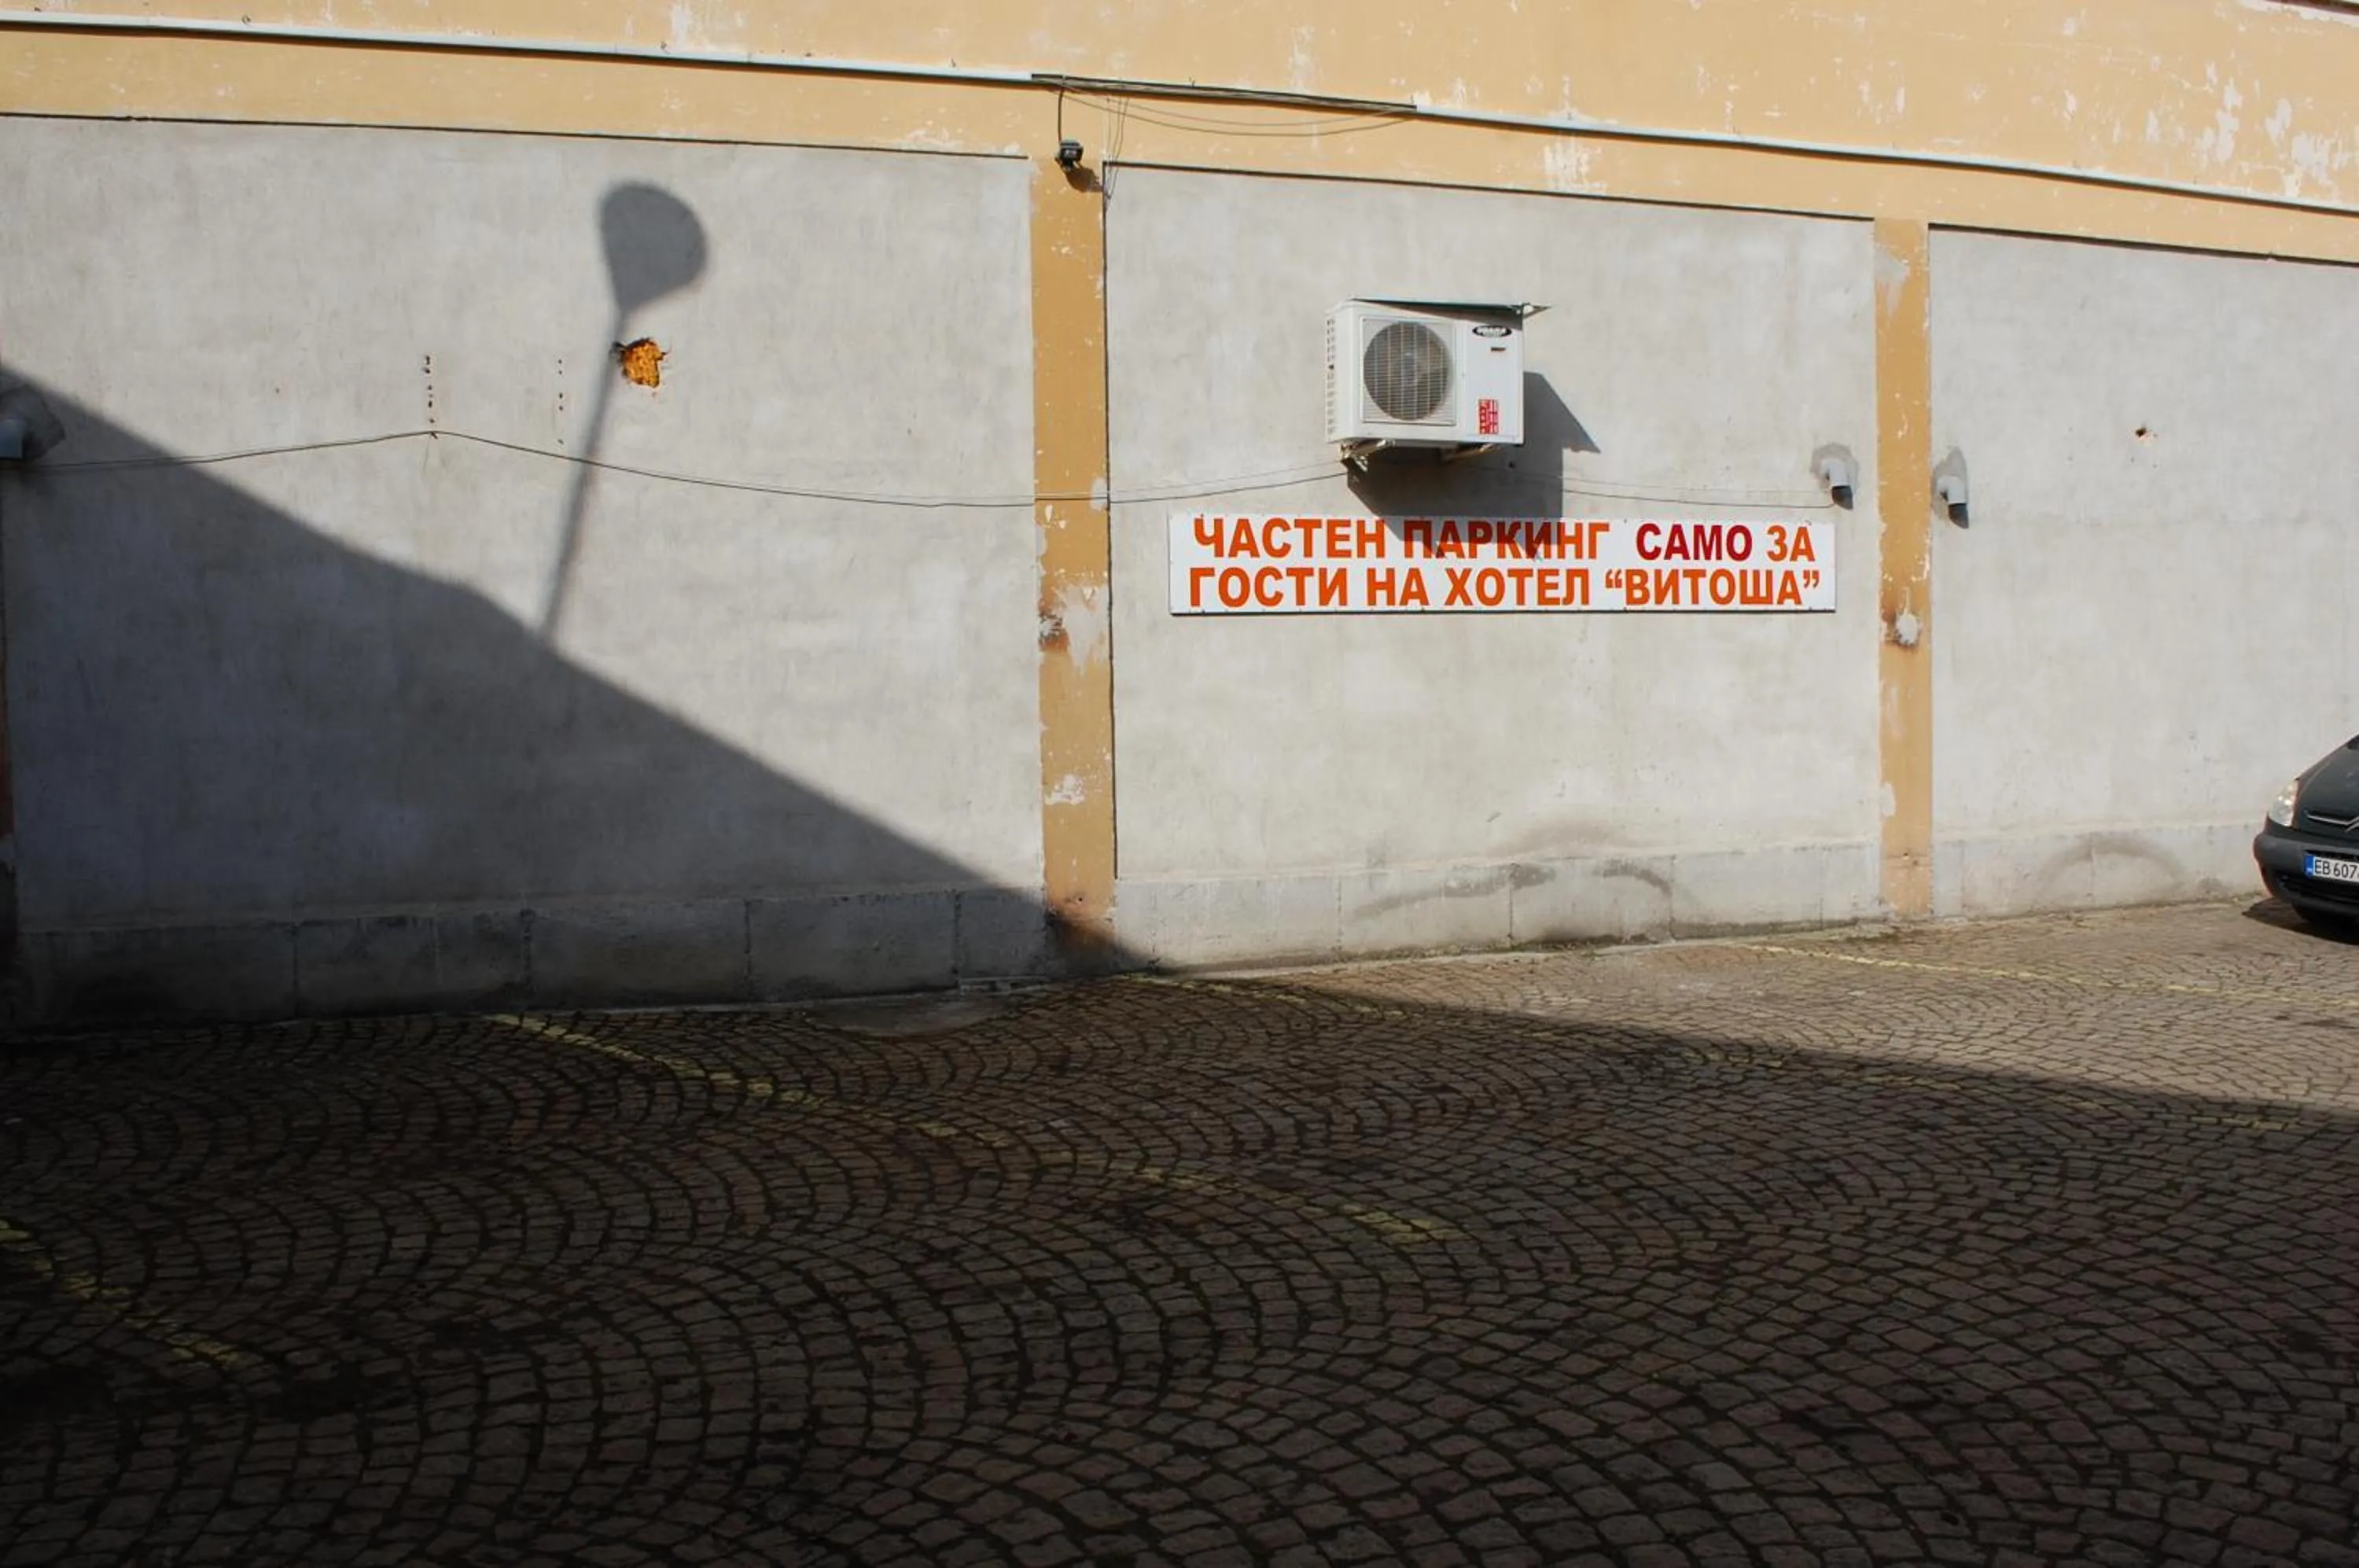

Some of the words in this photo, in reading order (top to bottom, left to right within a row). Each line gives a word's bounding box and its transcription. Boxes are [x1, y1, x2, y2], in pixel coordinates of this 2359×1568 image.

[1194, 517, 1386, 559] ЧАСТЕН
[1403, 519, 1610, 560] ПАРКИНГ
[1636, 523, 1753, 561] САМО
[1766, 525, 1815, 562] ЗА
[1189, 565, 1348, 608] ГОСТИ
[1366, 567, 1429, 607] НА
[1445, 567, 1589, 607] ХОТЕЛ
[1605, 568, 1820, 606] “ВИТОША”
[2314, 859, 2331, 875] EB
[2333, 862, 2359, 879] 607
